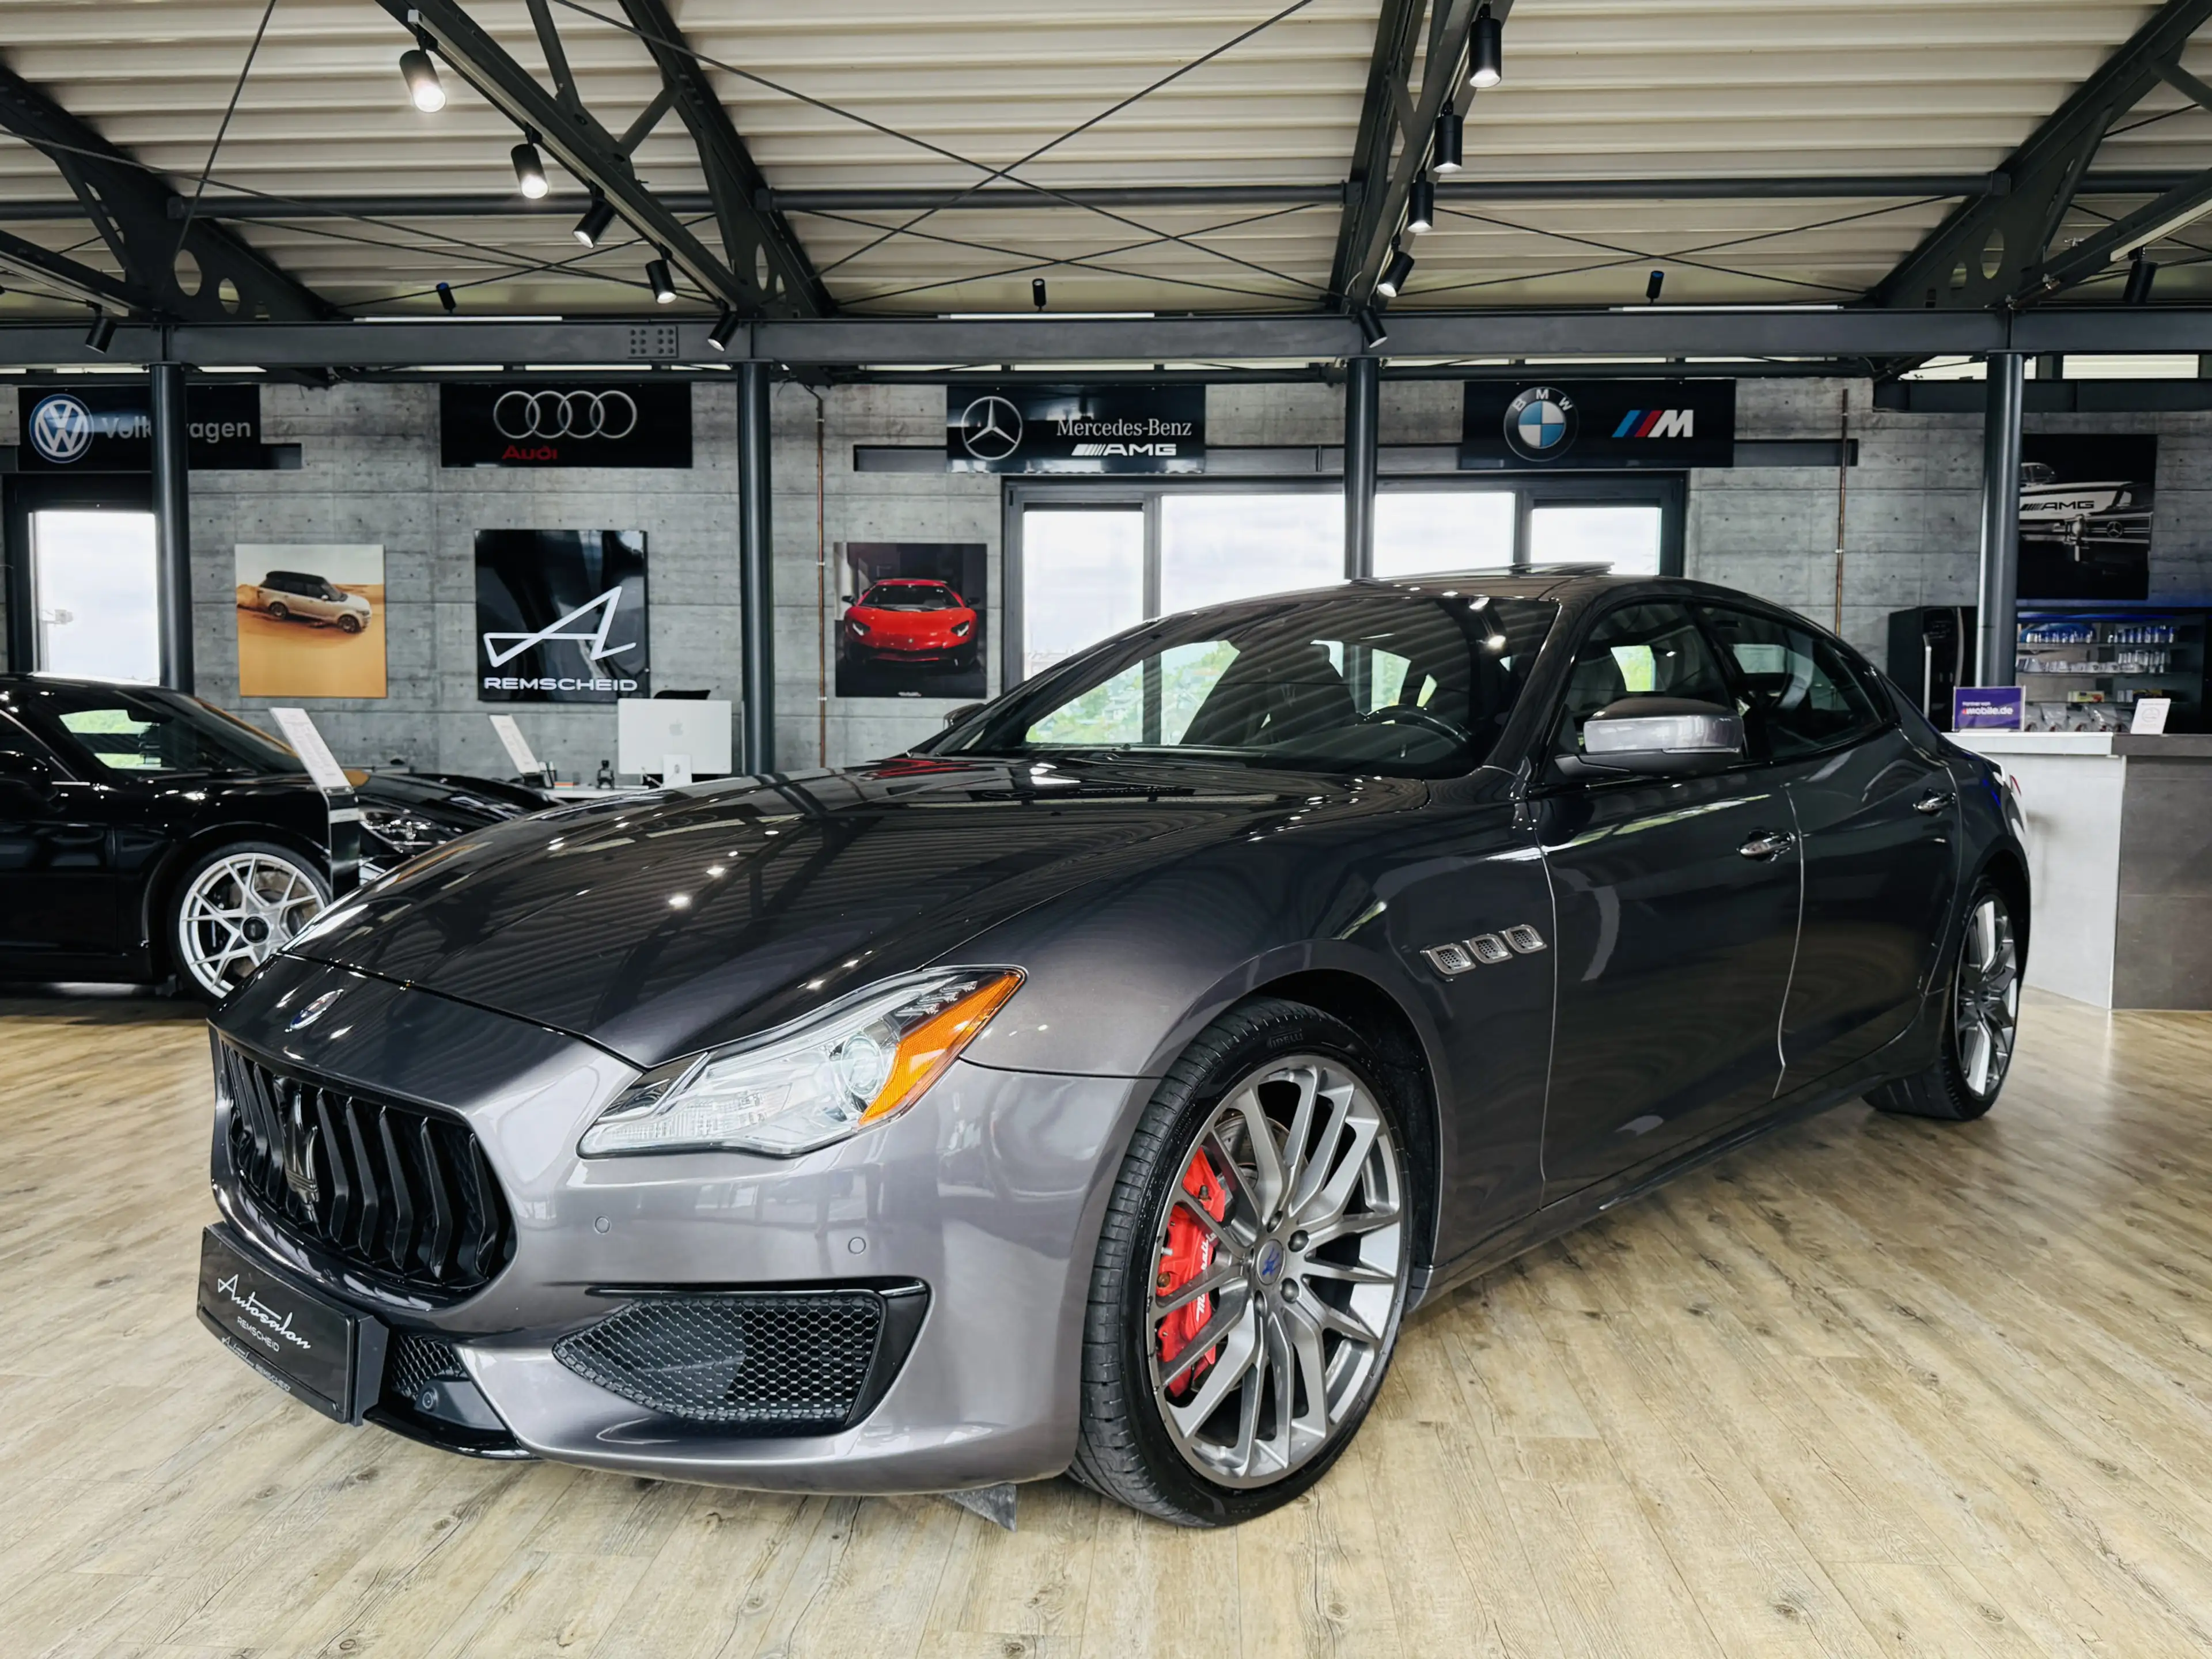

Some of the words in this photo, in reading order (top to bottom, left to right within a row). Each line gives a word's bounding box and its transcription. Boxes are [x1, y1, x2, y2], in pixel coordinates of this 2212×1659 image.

[1513, 388, 1573, 412] BMW
[101, 415, 251, 443] Volkagen
[1056, 418, 1192, 436] Mercedes-Benz
[501, 445, 558, 460] Audi
[2041, 501, 2094, 510] AMG
[483, 677, 638, 691] REMSCHEID
[217, 1274, 312, 1349] Autosalon
[237, 1316, 280, 1353] REMSCHEID
